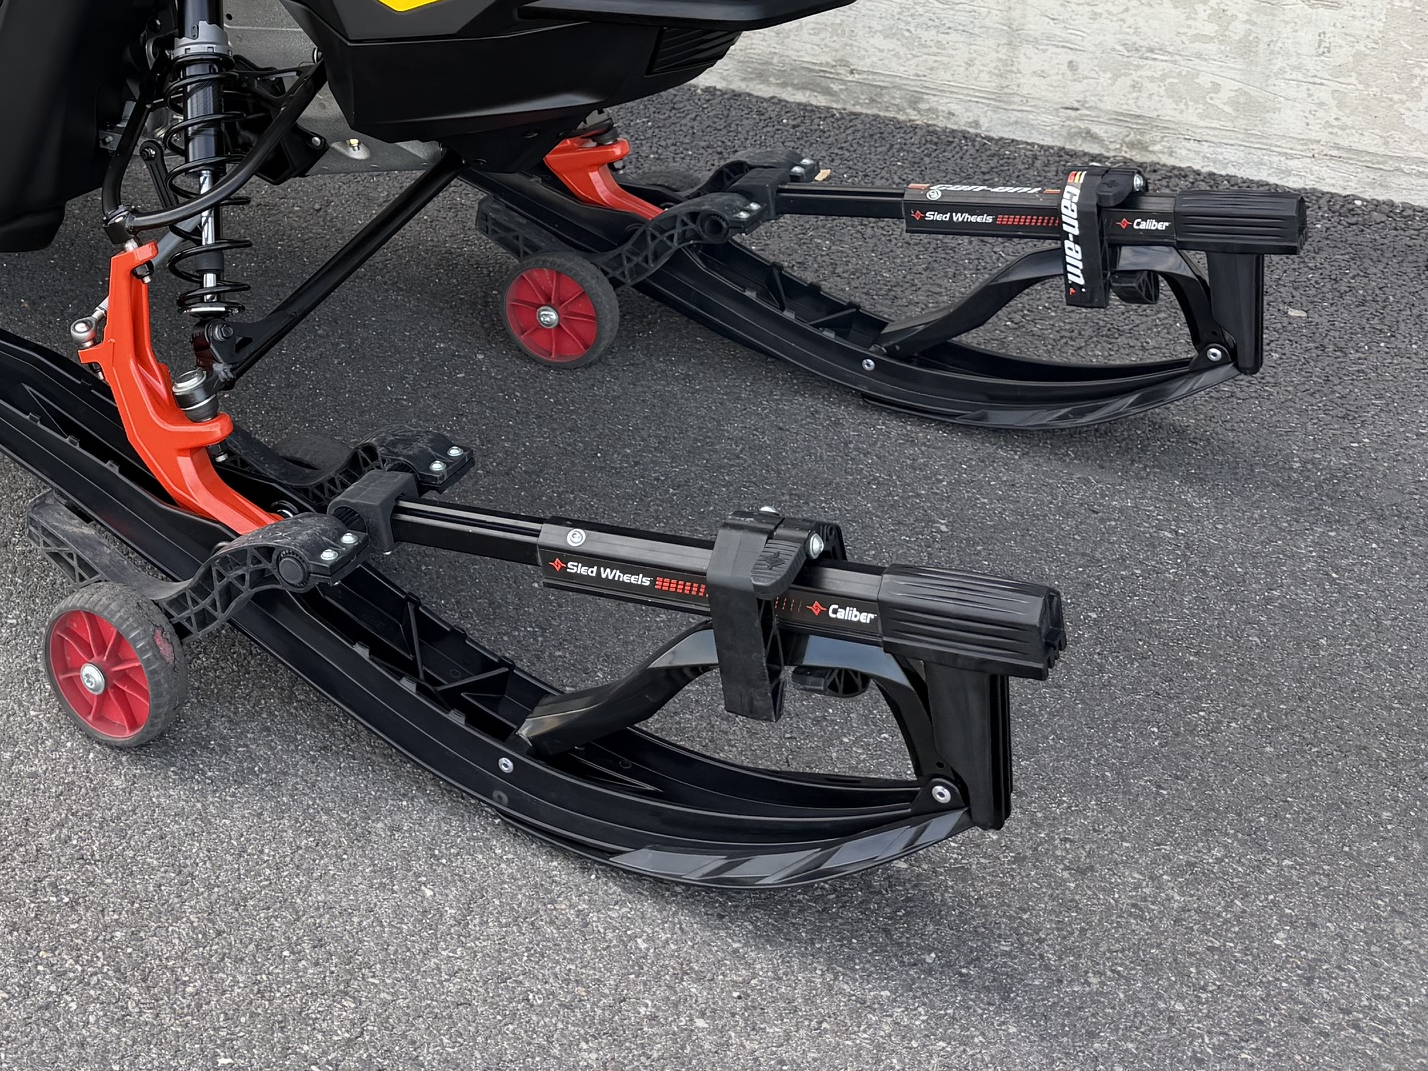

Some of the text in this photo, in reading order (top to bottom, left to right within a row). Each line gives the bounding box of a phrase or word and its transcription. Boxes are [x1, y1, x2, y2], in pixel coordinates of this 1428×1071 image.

[924, 211, 950, 222] Sled
[1133, 218, 1170, 231] Caliber
[566, 561, 597, 578] Sled
[828, 604, 874, 624] Caliber
